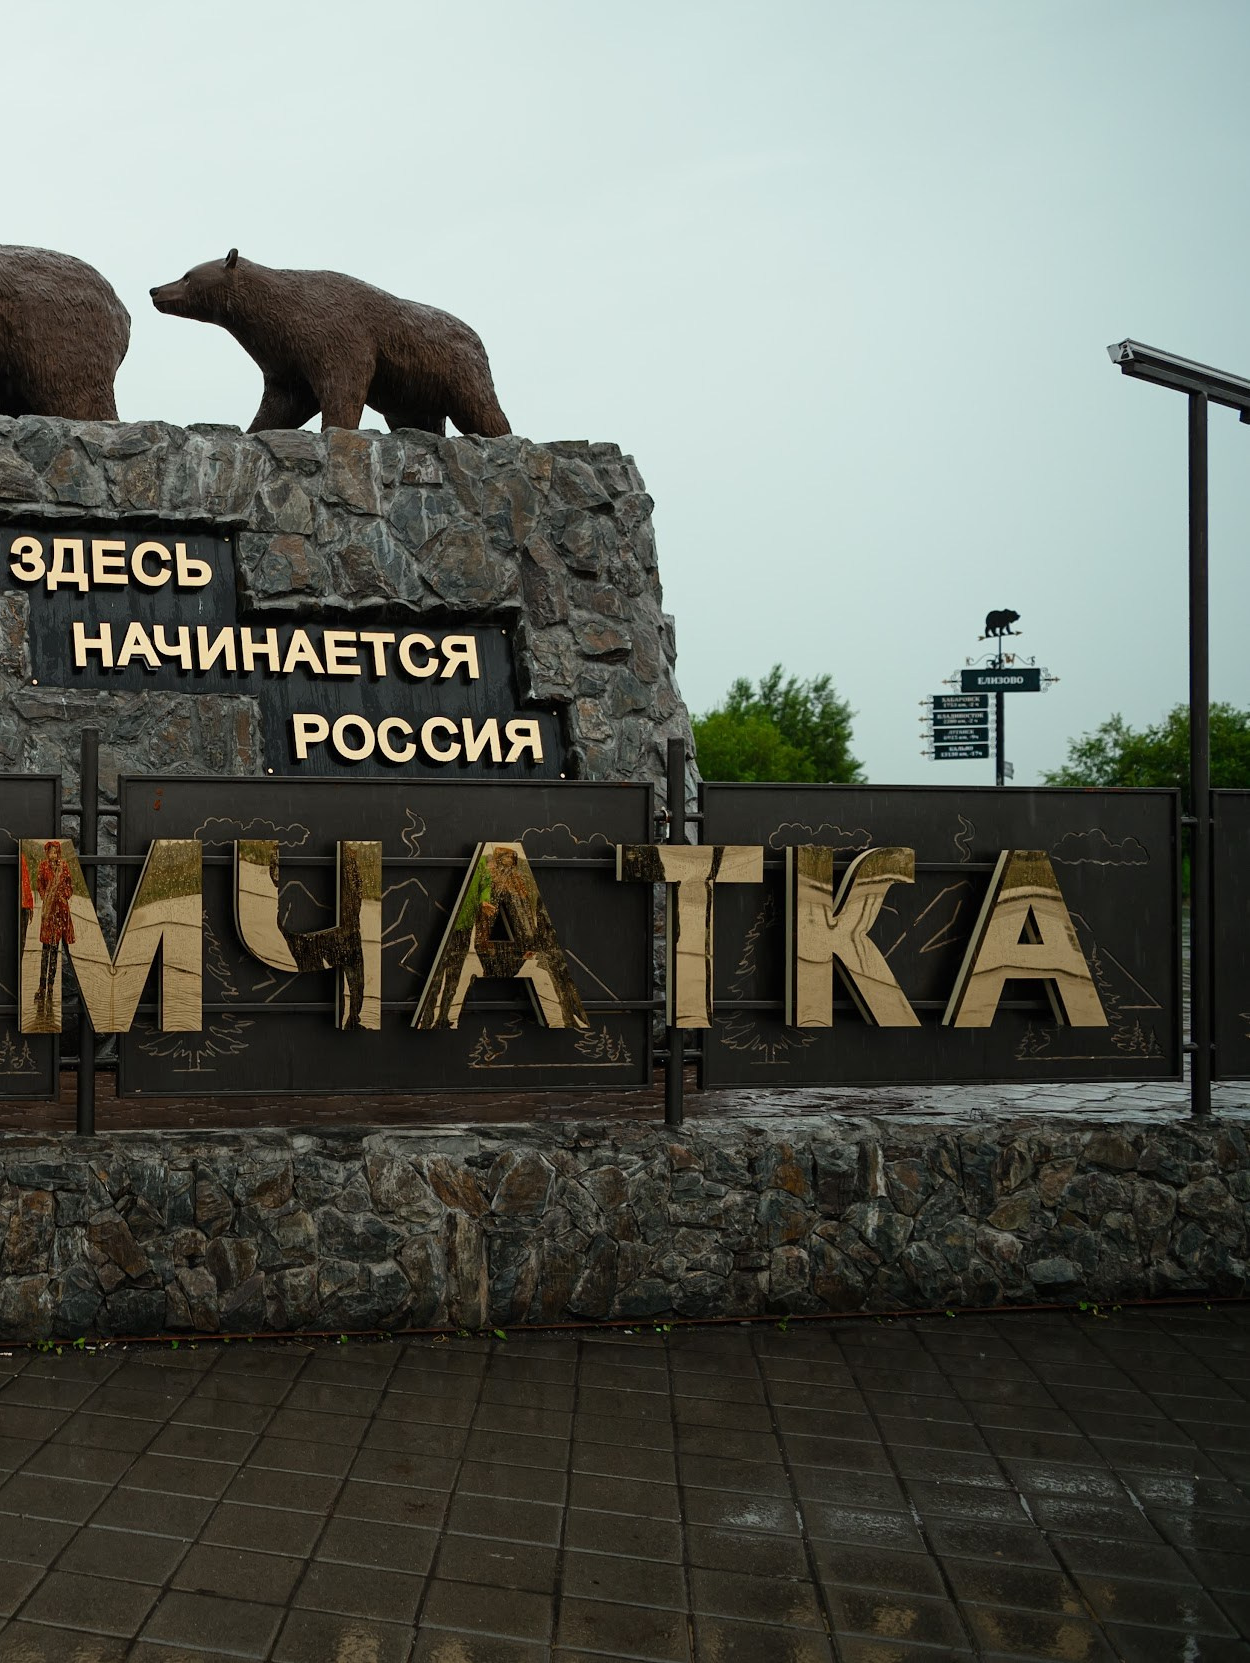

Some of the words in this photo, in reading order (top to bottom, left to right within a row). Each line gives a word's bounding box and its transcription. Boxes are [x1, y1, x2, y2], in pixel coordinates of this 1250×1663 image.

[9, 536, 213, 592] ЗДЕСЬ
[72, 621, 481, 679] НАЧИНАЕТСЯ
[977, 676, 1024, 685] ЕЛИЗОВО
[292, 713, 545, 764] РОССИЯ
